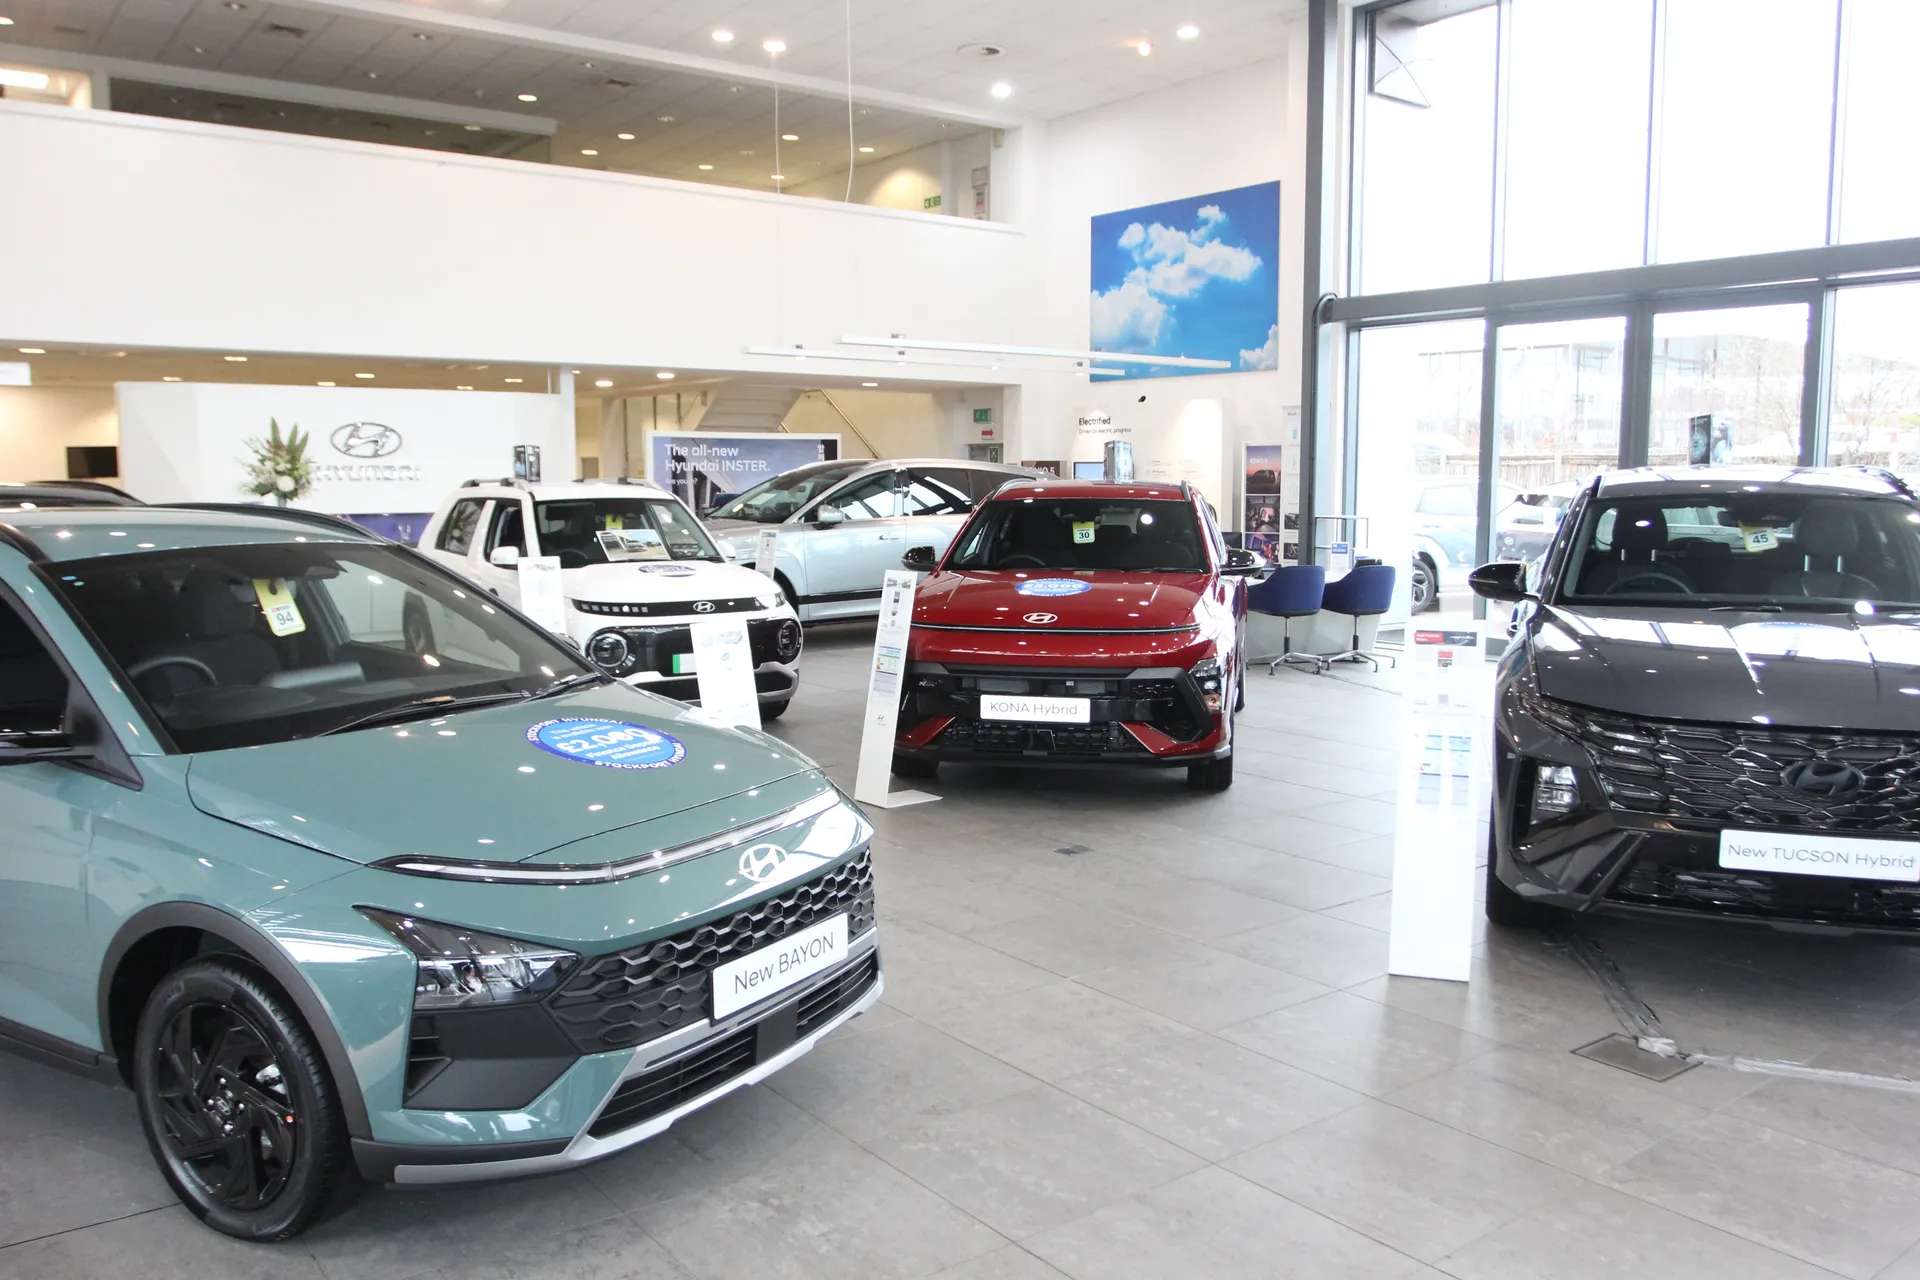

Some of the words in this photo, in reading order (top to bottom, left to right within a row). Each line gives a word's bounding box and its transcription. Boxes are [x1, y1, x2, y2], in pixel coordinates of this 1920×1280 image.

[1078, 416, 1111, 426] Electrified
[664, 444, 688, 456] The
[691, 444, 739, 456] all-new
[315, 464, 423, 481] HYUNDAI
[665, 459, 719, 474] Hyundai
[722, 460, 771, 472] INSTER.
[1078, 531, 1090, 540] 30
[1752, 533, 1769, 544] 45
[276, 611, 294, 626] 94
[990, 702, 1030, 713] KONA
[1033, 703, 1078, 716] Hybrid
[556, 728, 652, 754] £2,000
[1727, 843, 1767, 858] New
[1772, 847, 1850, 865] TUCSON
[1855, 853, 1915, 869] Hybrid
[734, 964, 774, 994] New
[779, 931, 834, 975] BAYON
